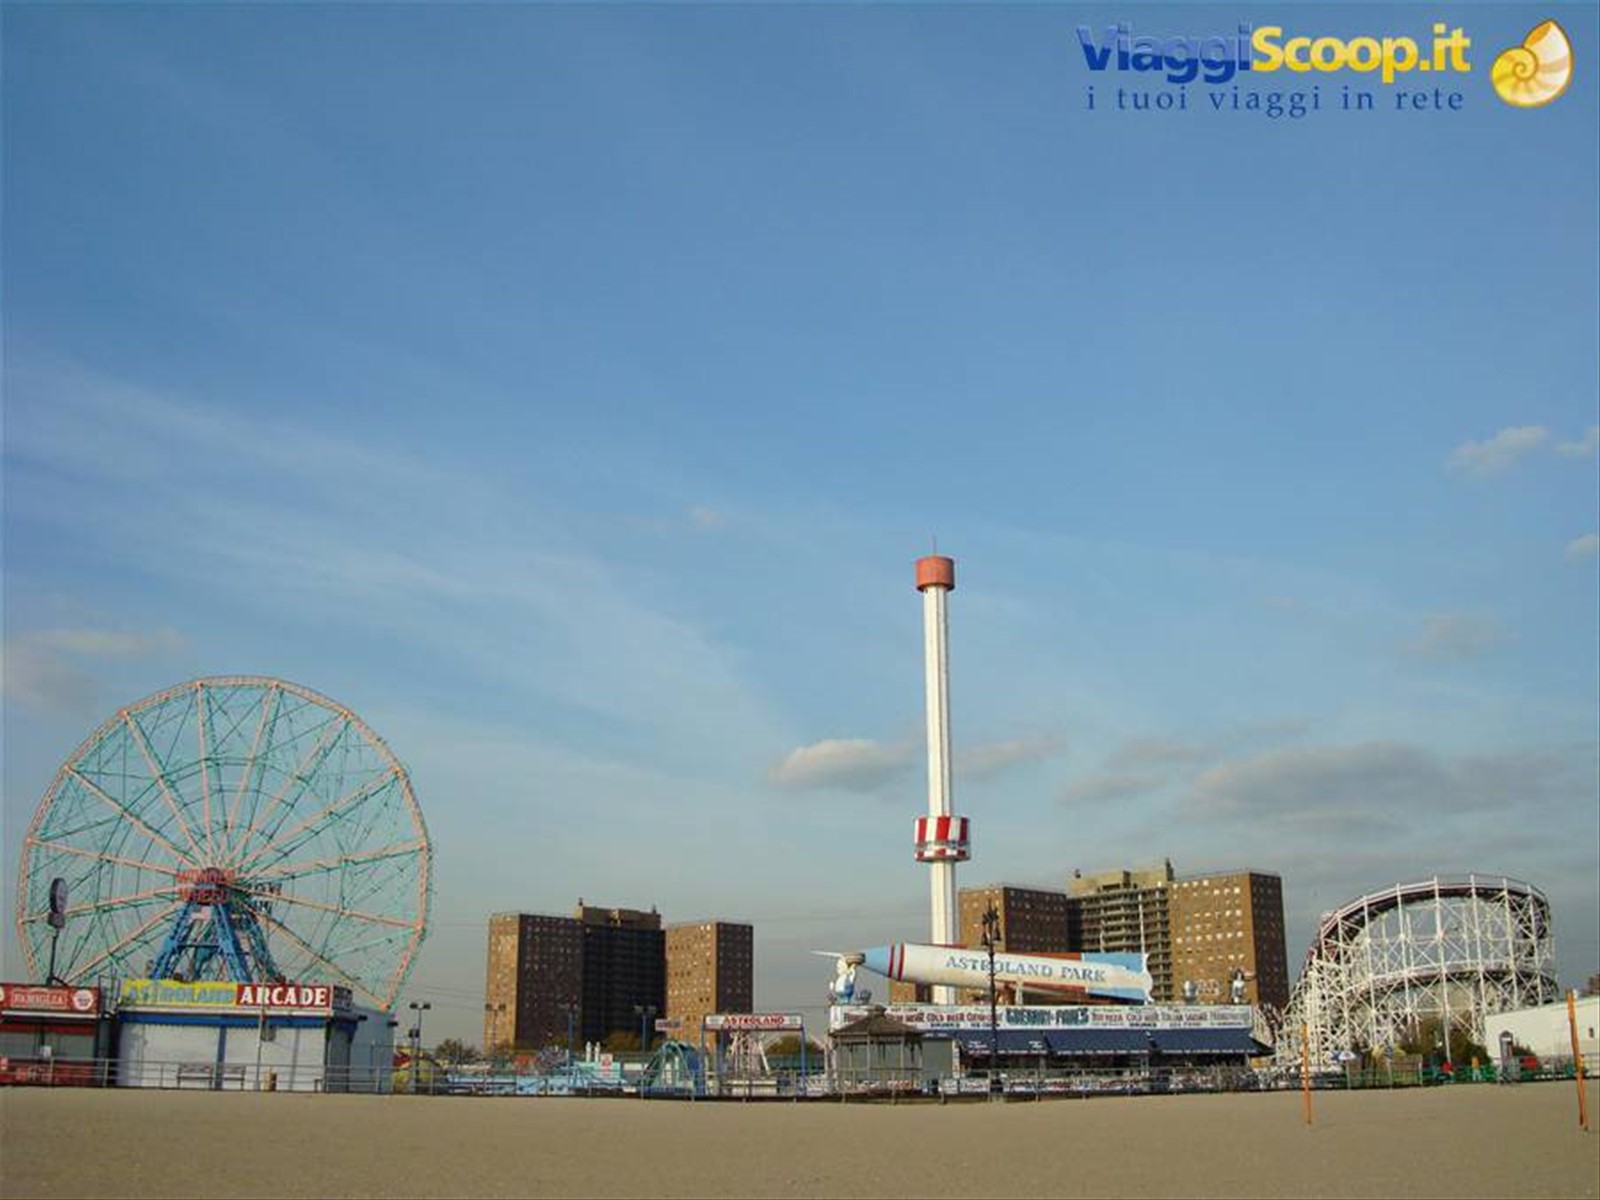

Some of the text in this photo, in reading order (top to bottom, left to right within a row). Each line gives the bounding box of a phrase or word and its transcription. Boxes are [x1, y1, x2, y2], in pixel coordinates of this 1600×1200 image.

[945, 956, 1107, 982] ASTROLAND PARK
[239, 985, 328, 1007] ARCADE
[723, 1015, 785, 1026] ASTROLAND
